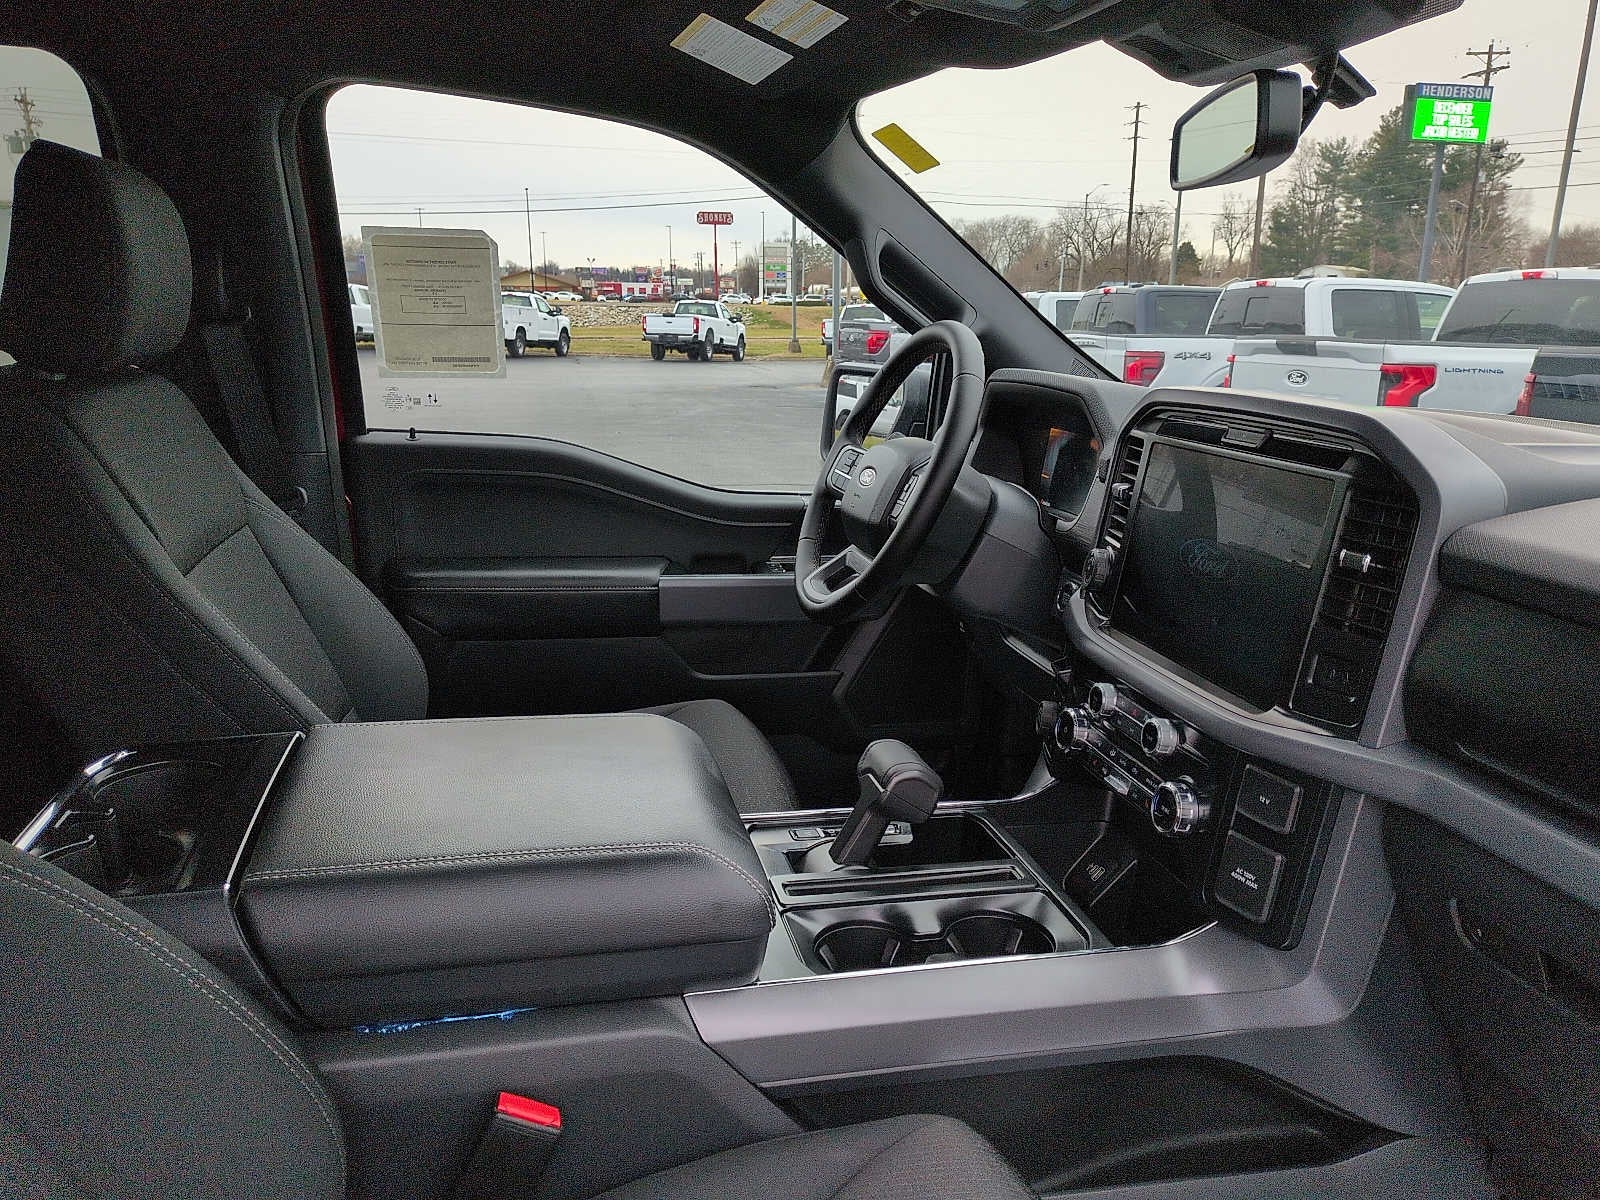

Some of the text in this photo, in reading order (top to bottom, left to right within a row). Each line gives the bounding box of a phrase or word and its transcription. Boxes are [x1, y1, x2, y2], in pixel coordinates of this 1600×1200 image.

[1422, 85, 1491, 98] HENDERSON
[1433, 101, 1474, 115] DECEMBER
[1432, 113, 1475, 128] TOP SALES
[1444, 367, 1504, 375] LIGHTNING
